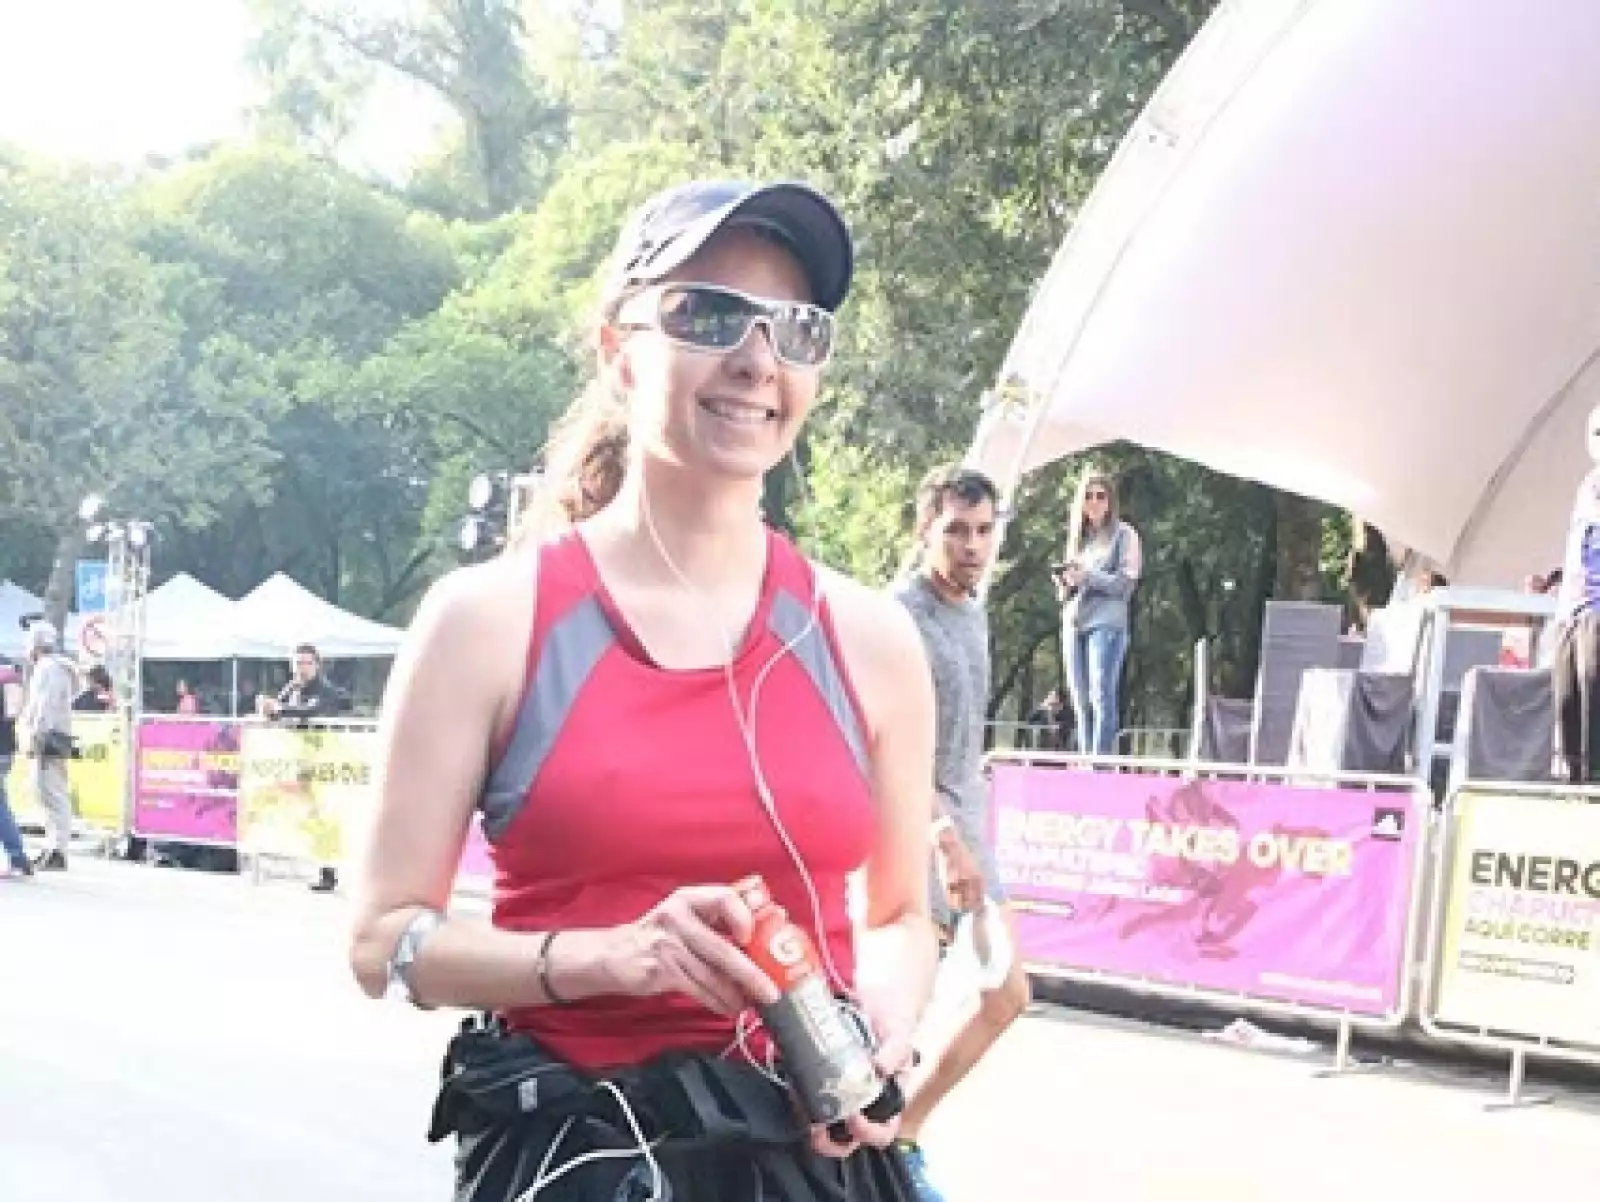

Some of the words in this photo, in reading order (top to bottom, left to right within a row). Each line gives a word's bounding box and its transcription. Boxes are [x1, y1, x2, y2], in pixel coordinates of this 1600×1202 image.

[1125, 819, 1240, 867] TAKES
[1248, 832, 1351, 878] OVER
[1470, 851, 1600, 899] ENERG
